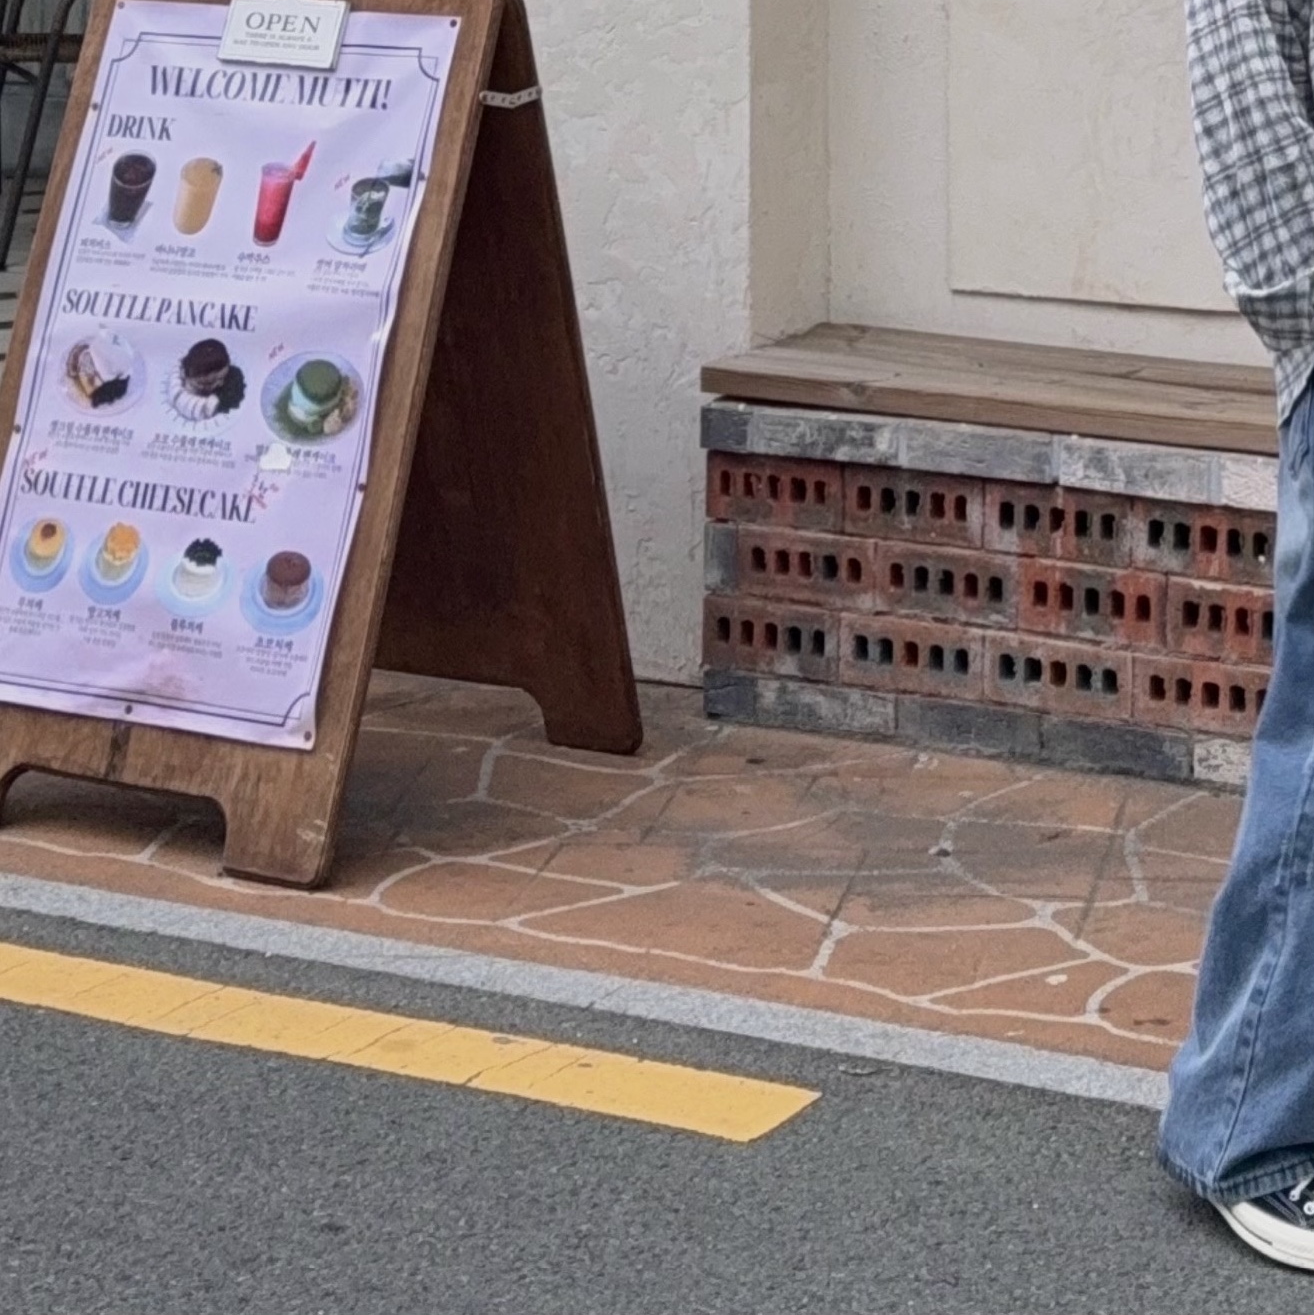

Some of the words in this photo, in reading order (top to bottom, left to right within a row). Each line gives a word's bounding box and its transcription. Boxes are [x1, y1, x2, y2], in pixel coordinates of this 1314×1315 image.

[245, 12, 320, 34] OPEN
[150, 65, 290, 104] WELCOME
[107, 114, 176, 141] DRINK
[155, 297, 258, 332] PANCAKE
[117, 480, 256, 523] CHEESECAKE
